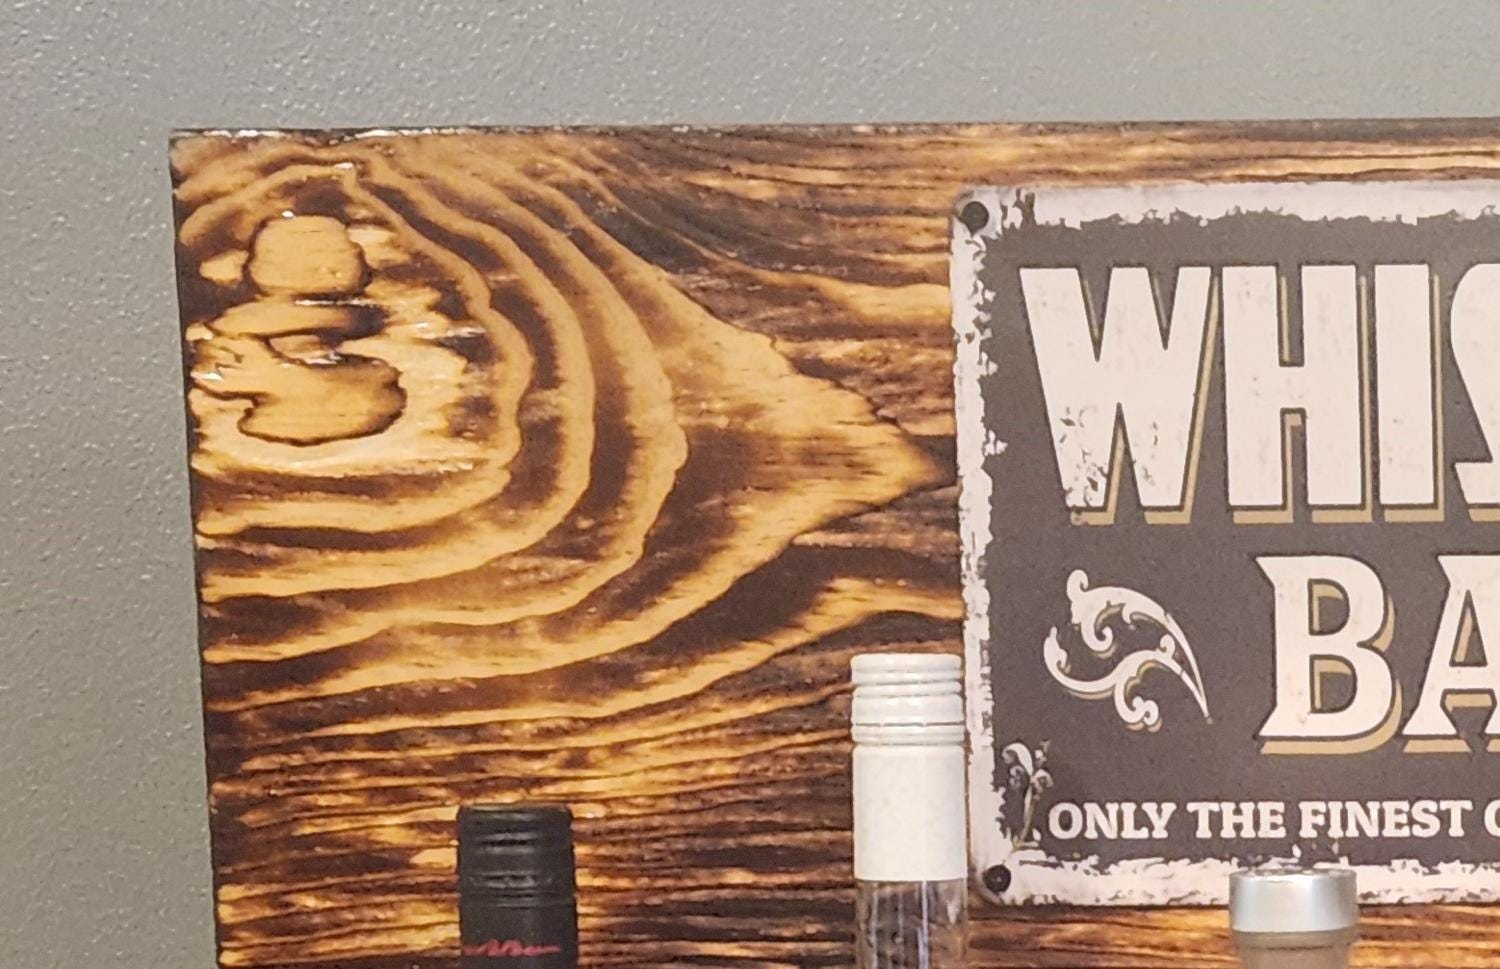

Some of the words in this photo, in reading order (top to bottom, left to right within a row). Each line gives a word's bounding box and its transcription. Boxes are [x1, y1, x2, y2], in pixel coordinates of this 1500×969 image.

[1048, 801, 1177, 840] ONLY
[1186, 801, 1286, 838] THE
[1299, 800, 1472, 838] FINEST
